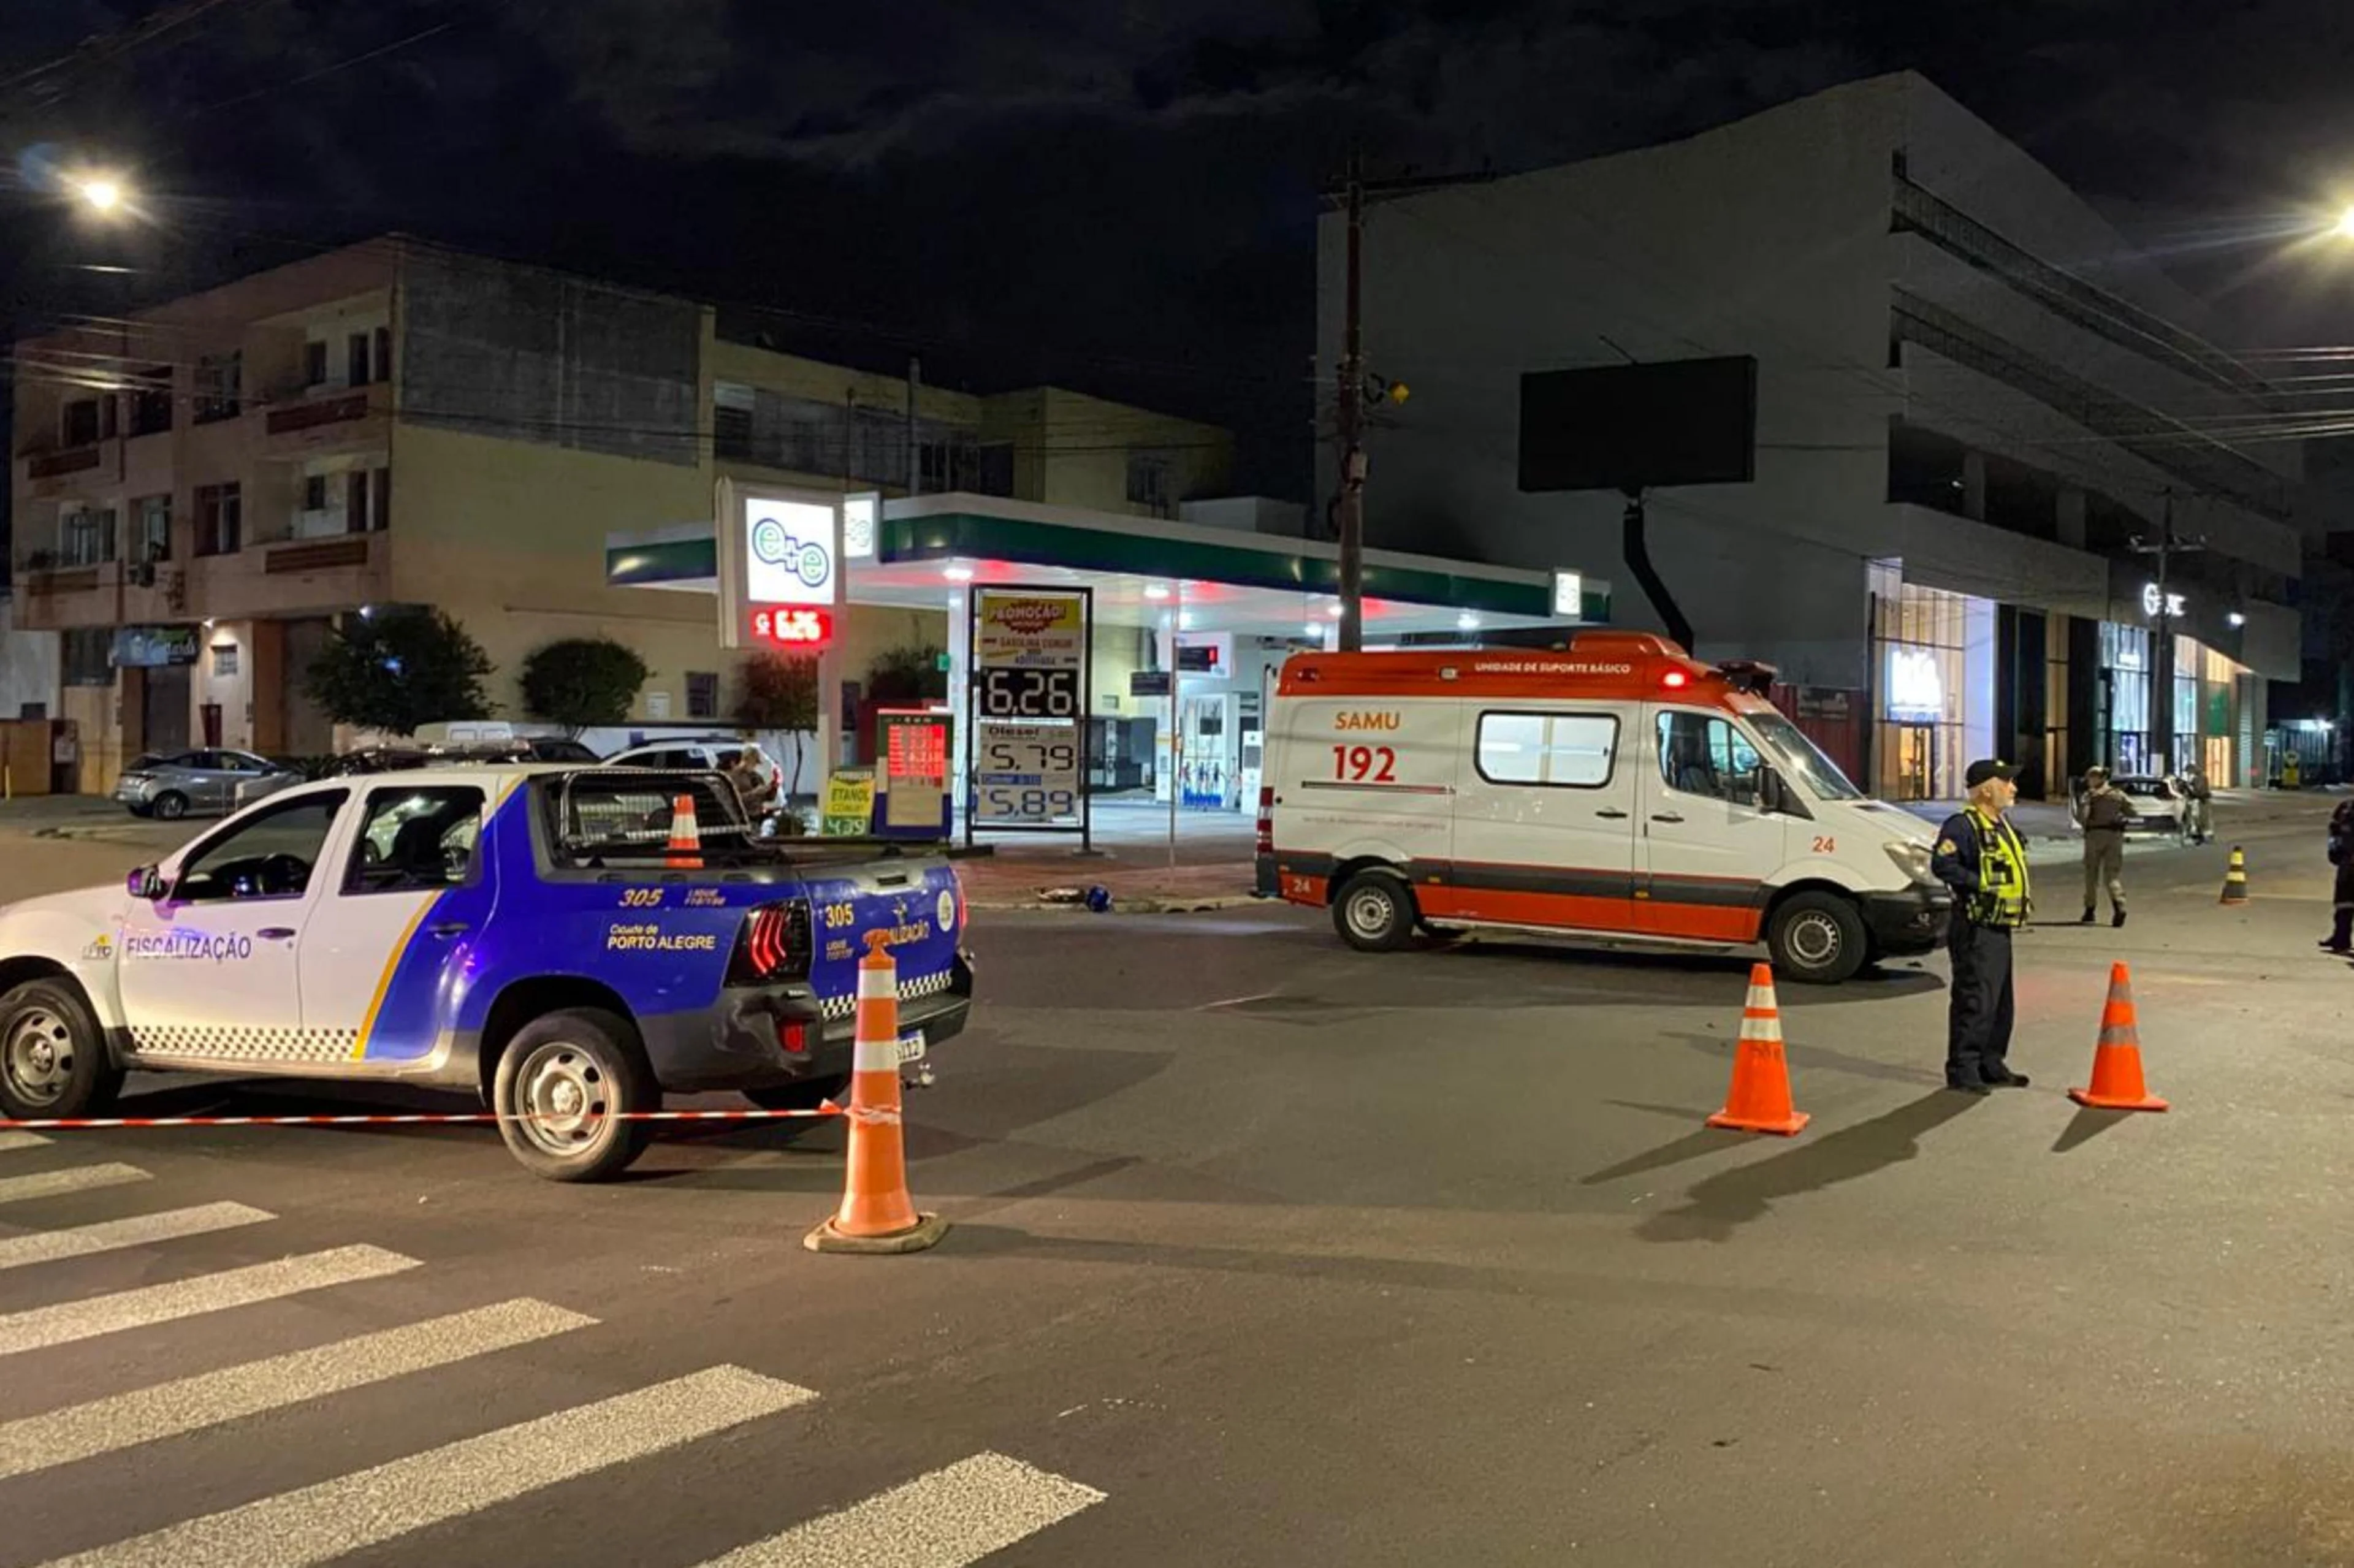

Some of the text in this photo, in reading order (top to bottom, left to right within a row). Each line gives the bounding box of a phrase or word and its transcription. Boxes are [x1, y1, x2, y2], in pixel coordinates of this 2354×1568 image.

[1475, 661, 1631, 674] UNIDADE DE SUPORTE BÁSICO
[1335, 712, 1400, 730] SAMU
[989, 726, 1040, 736] Diesel
[991, 744, 1074, 771] 5,79
[1333, 745, 1396, 782] 192
[831, 788, 870, 802] ETANOL
[989, 790, 1073, 816] 5,89
[1812, 836, 1834, 853] 24
[1293, 877, 1311, 893] 24
[619, 889, 664, 907] 305
[825, 903, 854, 927] 305
[646, 923, 659, 935] de
[127, 931, 251, 964] FISCALIZAÇÃO
[608, 935, 716, 950] PORTO ALEGRE
